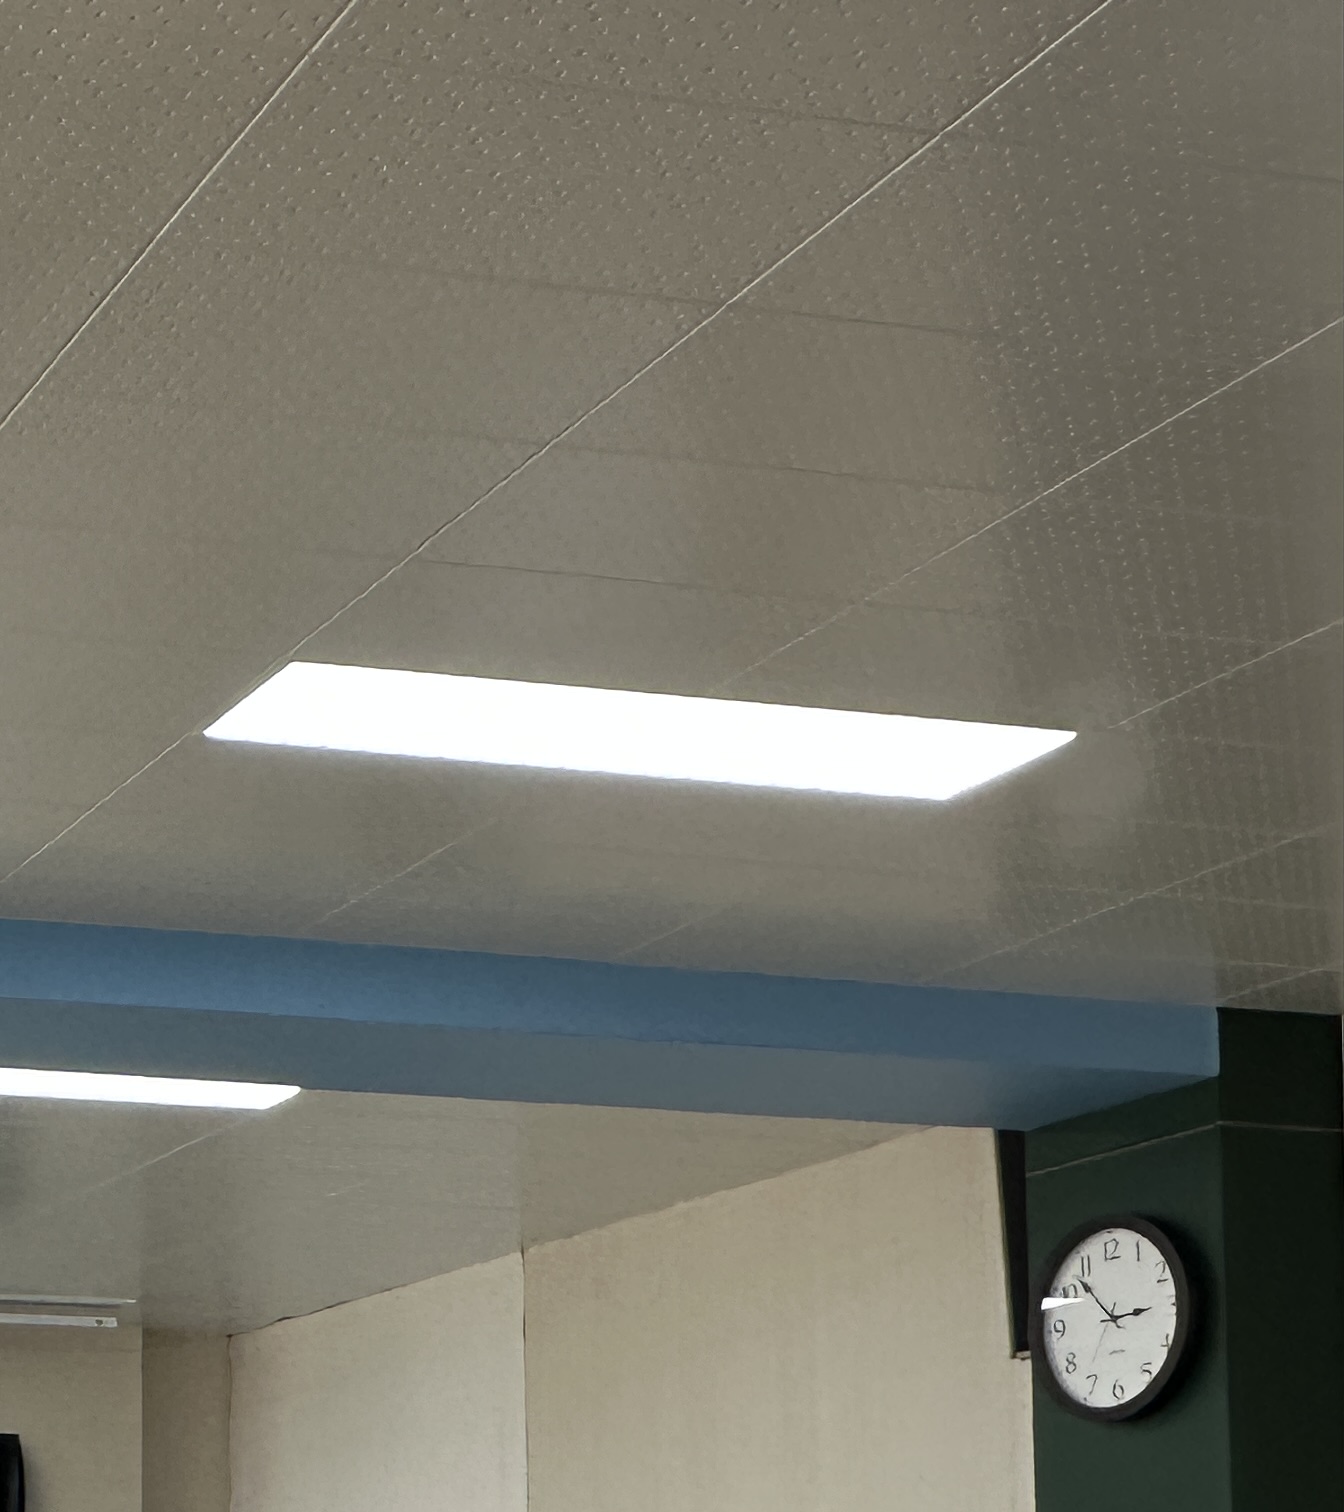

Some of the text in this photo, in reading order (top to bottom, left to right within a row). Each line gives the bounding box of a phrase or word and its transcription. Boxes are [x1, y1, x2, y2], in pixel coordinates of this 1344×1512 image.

[1155, 1260, 1169, 1283] 2
[1053, 1319, 1066, 1339] 9
[1065, 1352, 1077, 1374] 8
[1140, 1362, 1153, 1382] 5
[1086, 1374, 1098, 1396] 7
[1112, 1379, 1125, 1401] 6
